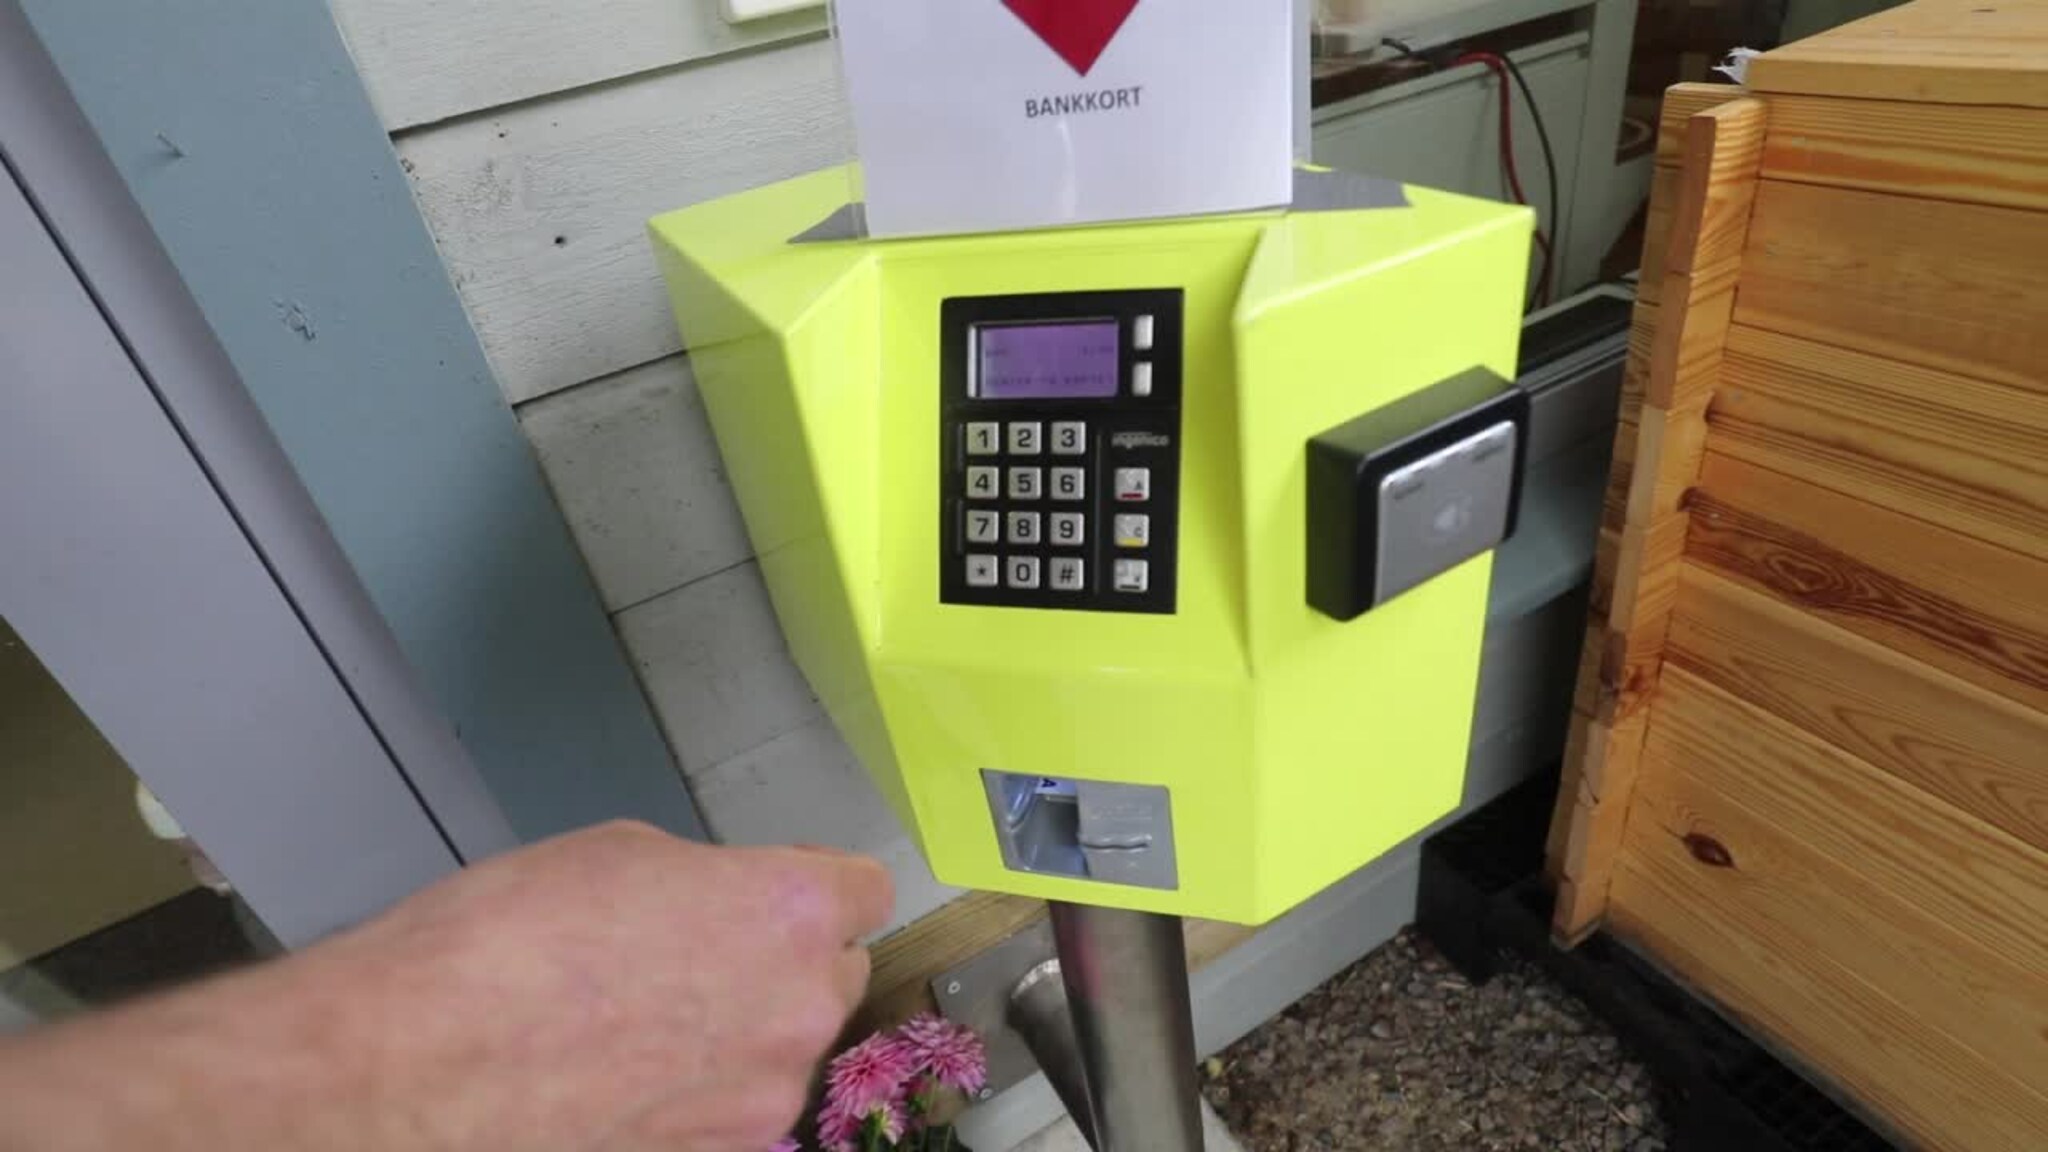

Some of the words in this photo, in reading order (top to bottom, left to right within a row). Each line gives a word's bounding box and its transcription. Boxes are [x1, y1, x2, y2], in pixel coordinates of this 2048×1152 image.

[1025, 86, 1142, 118] BANKKORT
[977, 429, 988, 448] 1
[1017, 428, 1032, 448] 2
[1060, 428, 1076, 448] 3
[975, 473, 989, 492] 4
[1017, 473, 1032, 493] 5
[1059, 473, 1075, 493] 6
[975, 517, 989, 536] 7
[1016, 518, 1031, 537] 8
[1059, 519, 1074, 539] 9
[1016, 563, 1031, 582] 0
[1059, 564, 1075, 584] #
